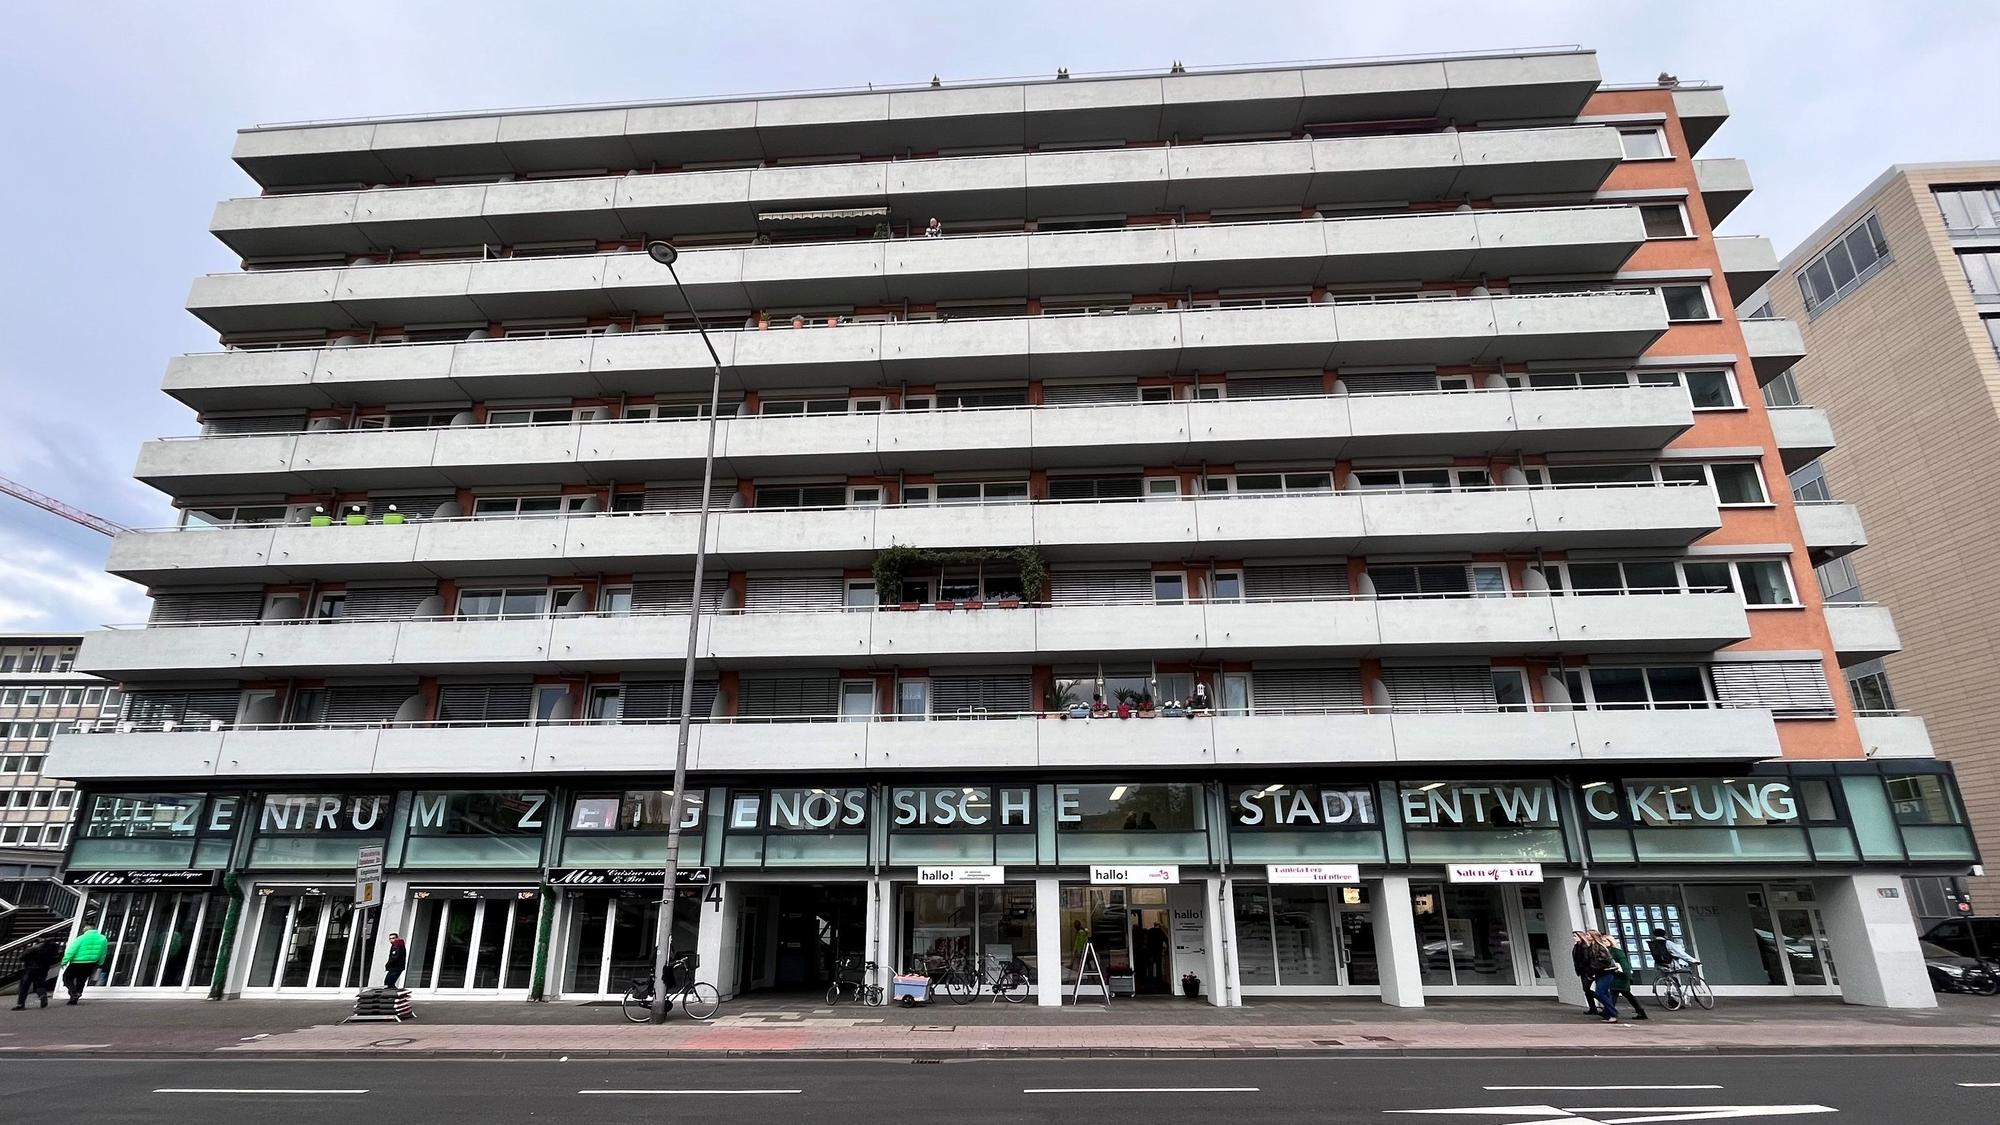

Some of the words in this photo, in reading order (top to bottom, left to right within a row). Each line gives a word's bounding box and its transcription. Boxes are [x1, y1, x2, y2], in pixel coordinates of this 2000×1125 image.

[171, 794, 447, 832] ZENTRUM
[73, 871, 125, 885] Min
[550, 869, 605, 884] Min
[607, 869, 643, 877] Cuisine
[624, 876, 646, 884] Bar
[921, 869, 954, 881] hallo!
[1095, 869, 1128, 880] hallo!
[704, 883, 723, 913] 4
